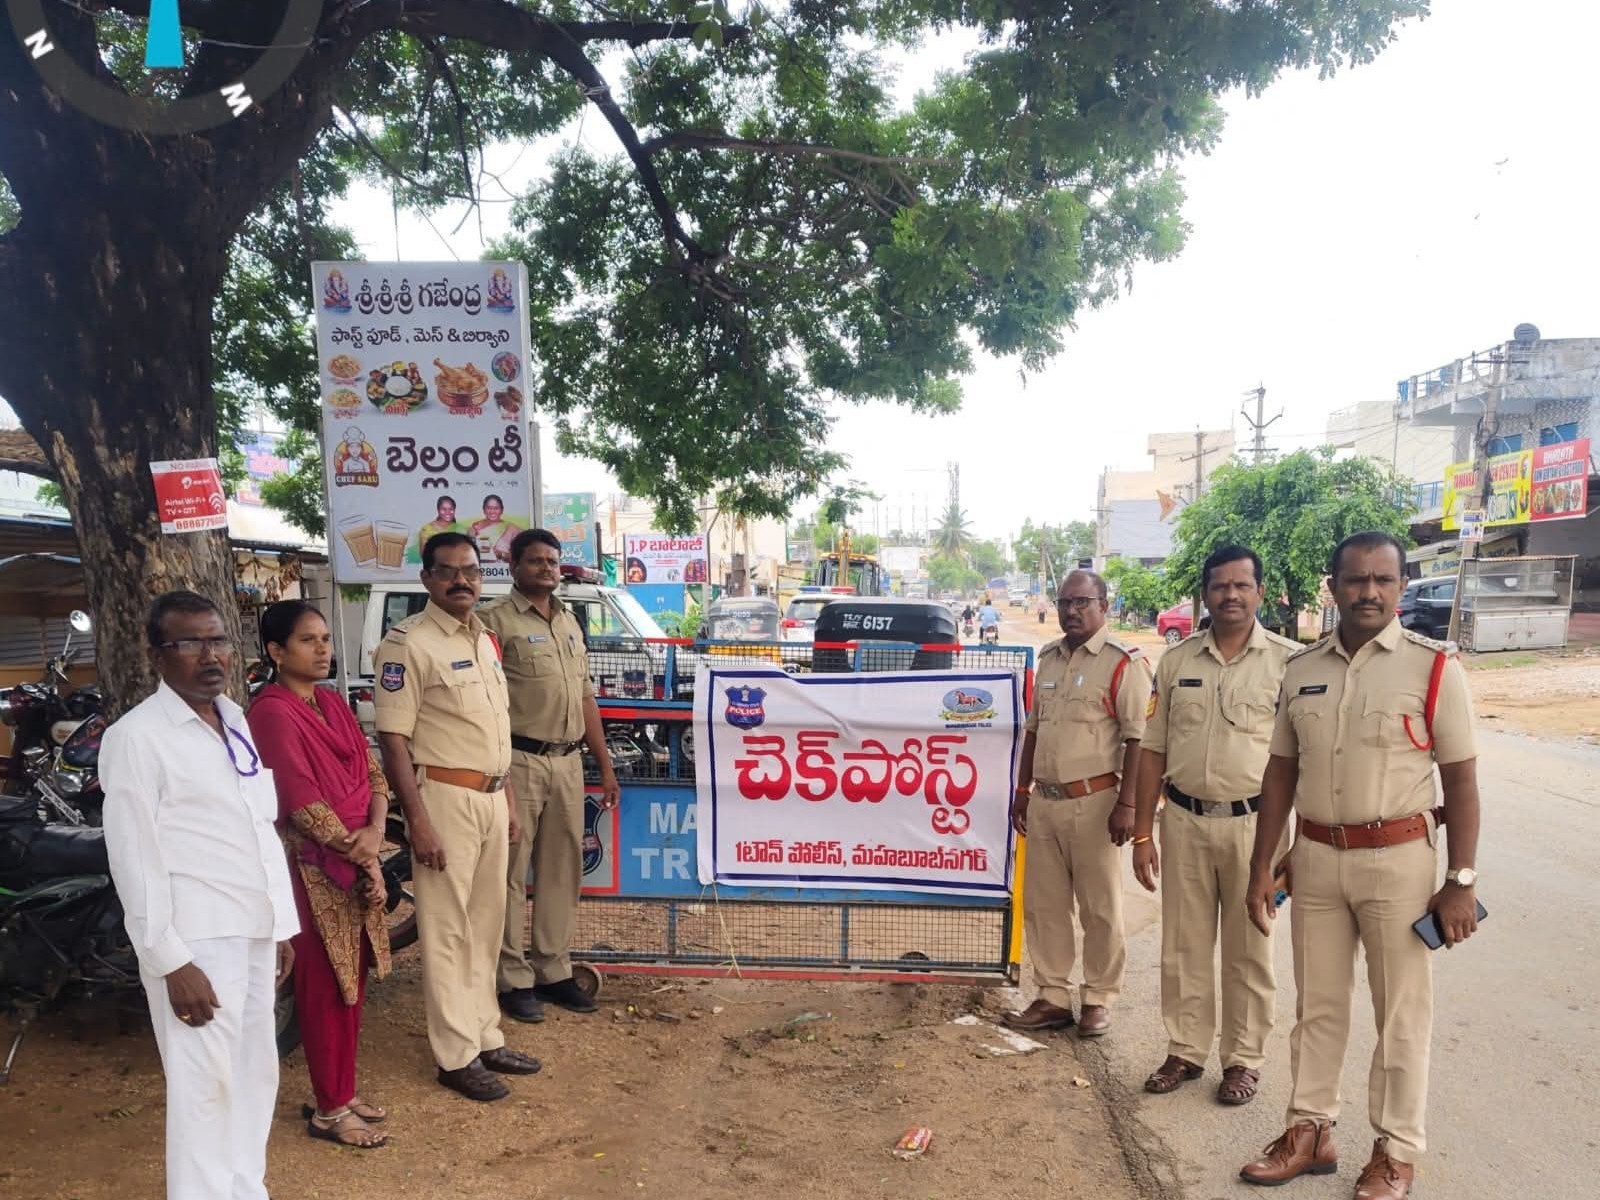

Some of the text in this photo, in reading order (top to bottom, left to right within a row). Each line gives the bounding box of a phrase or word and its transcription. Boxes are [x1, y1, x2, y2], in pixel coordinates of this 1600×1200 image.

[418, 278, 482, 315] గజేంద్ర
[413, 325, 444, 343] మెస్
[447, 328, 461, 343] &
[462, 329, 510, 348] బిర్యాని
[386, 424, 523, 489] బెల్లం టీ
[166, 508, 177, 516] TV
[863, 615, 894, 631] 6137
